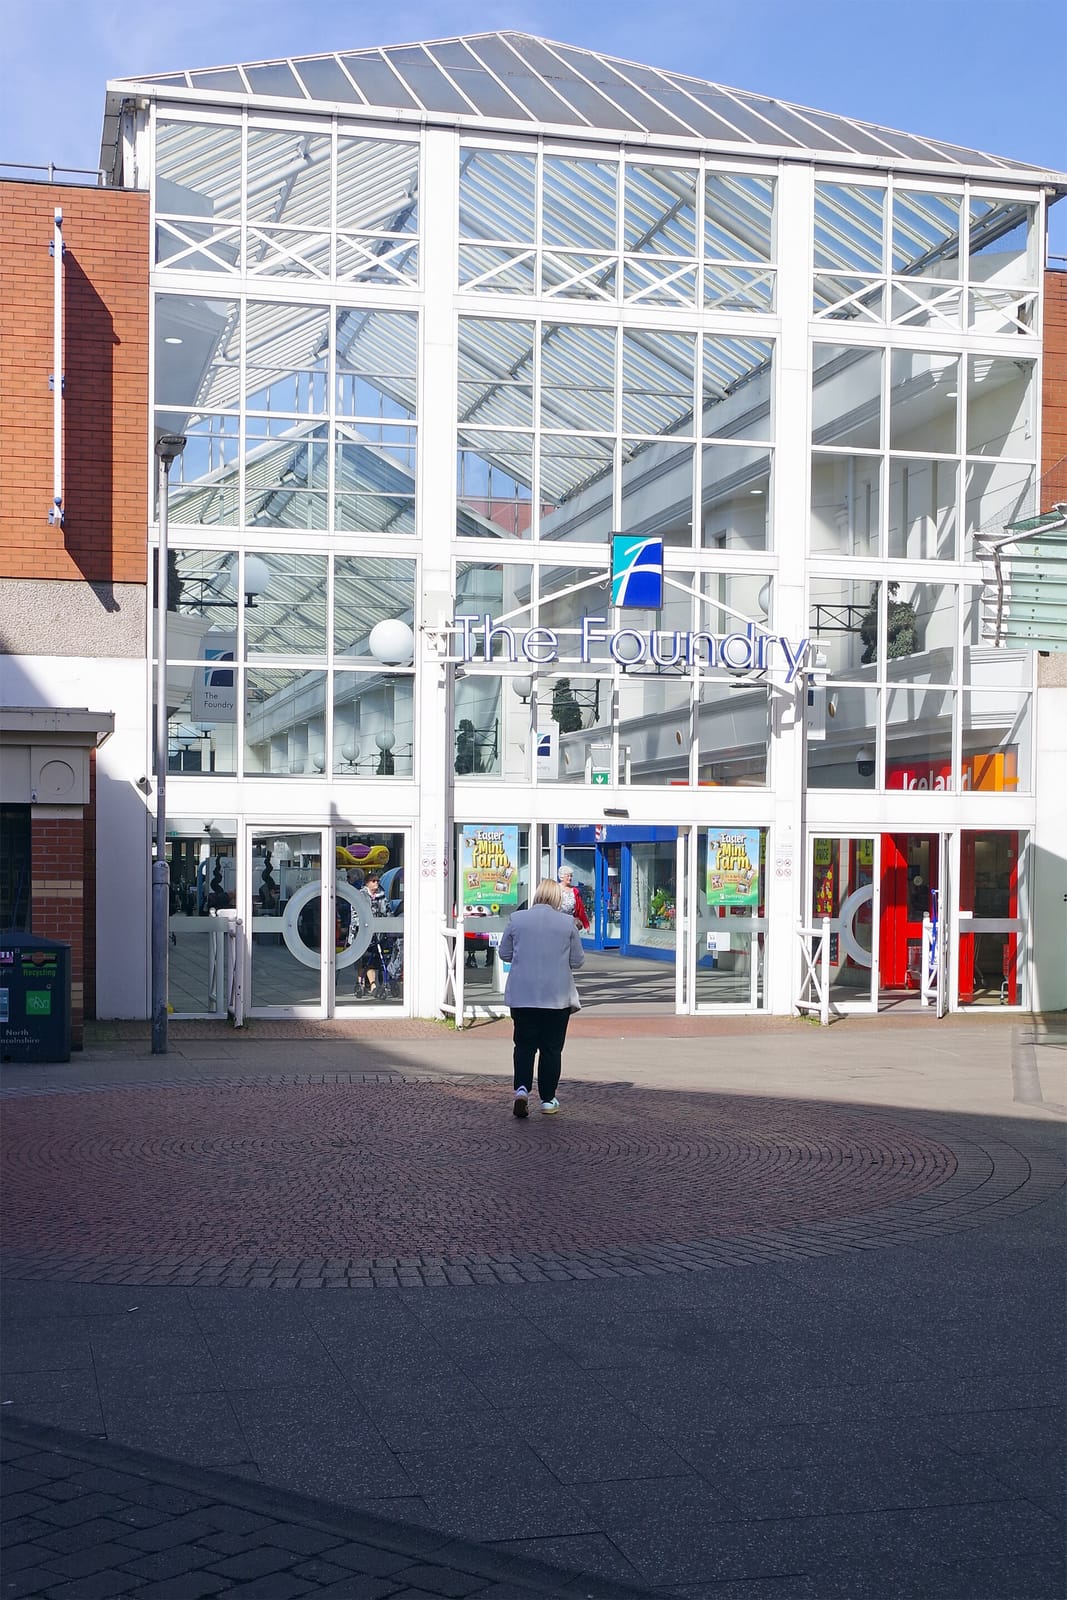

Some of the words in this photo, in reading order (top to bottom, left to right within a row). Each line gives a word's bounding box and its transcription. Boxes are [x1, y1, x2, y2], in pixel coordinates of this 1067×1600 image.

[455, 613, 558, 663] The
[581, 615, 810, 683] Foundry
[204, 701, 233, 710] Foundry
[477, 840, 505, 855] Mini
[720, 843, 747, 858] Mini
[23, 968, 56, 977] Recycling
[0, 1036, 40, 1044] ncolnshire
